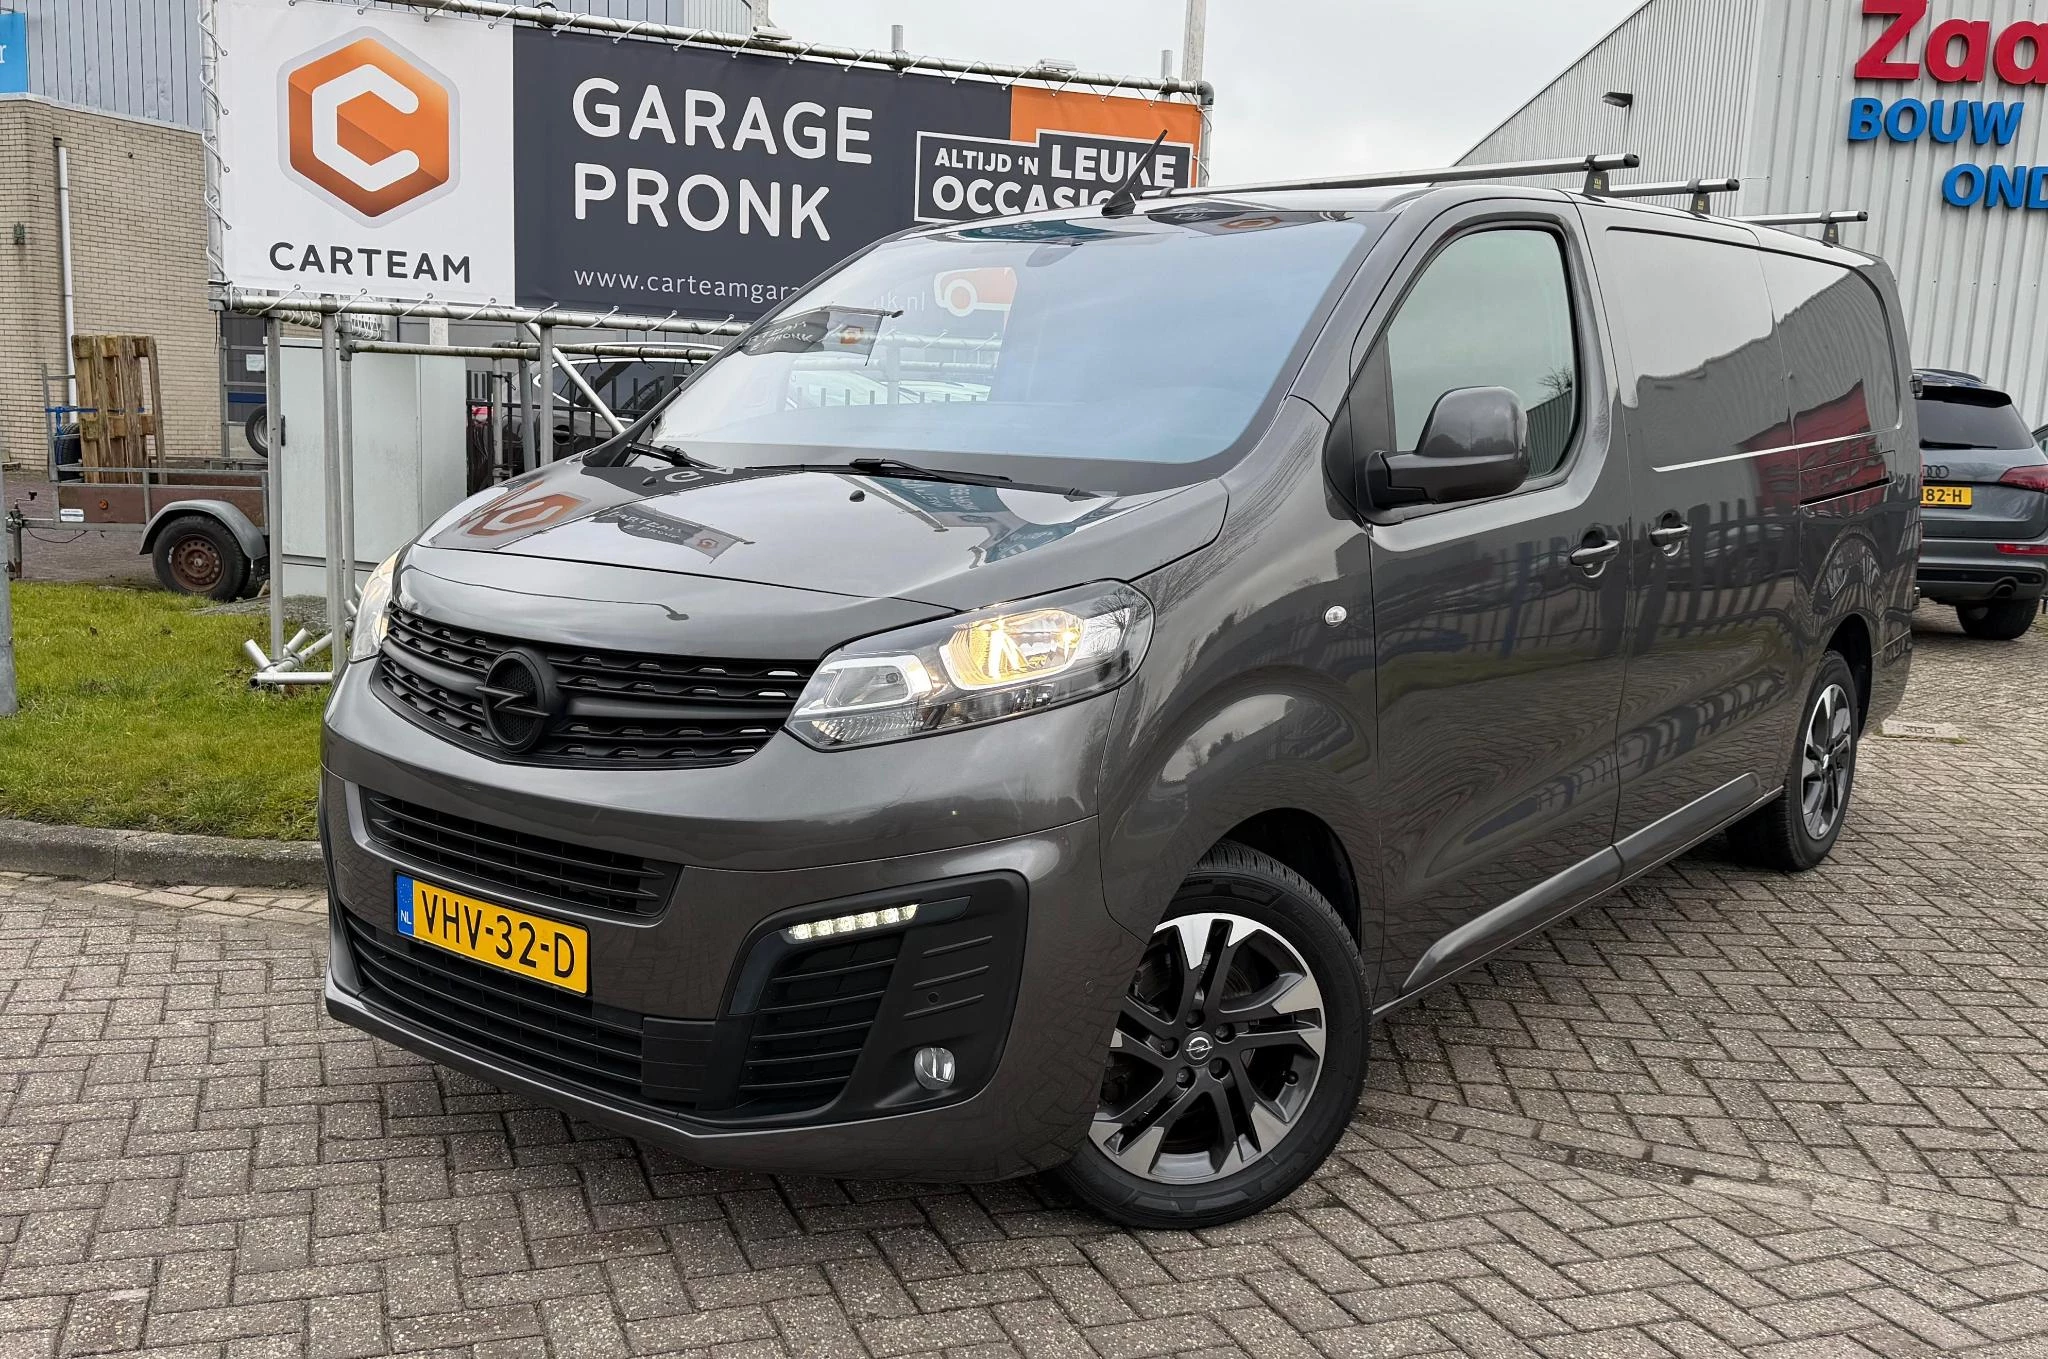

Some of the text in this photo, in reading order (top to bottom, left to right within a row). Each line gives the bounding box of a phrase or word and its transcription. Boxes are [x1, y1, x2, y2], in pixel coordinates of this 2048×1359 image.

[1854, 0, 2048, 85] Zaa
[572, 77, 873, 165] GARAGE
[1848, 97, 2025, 146] BOUW
[934, 147, 1012, 173] ALTIJD
[574, 162, 831, 241] PRONK
[269, 241, 471, 284] CARTEAM
[400, 909, 413, 926] NL
[421, 890, 576, 979] VHV-32-D
